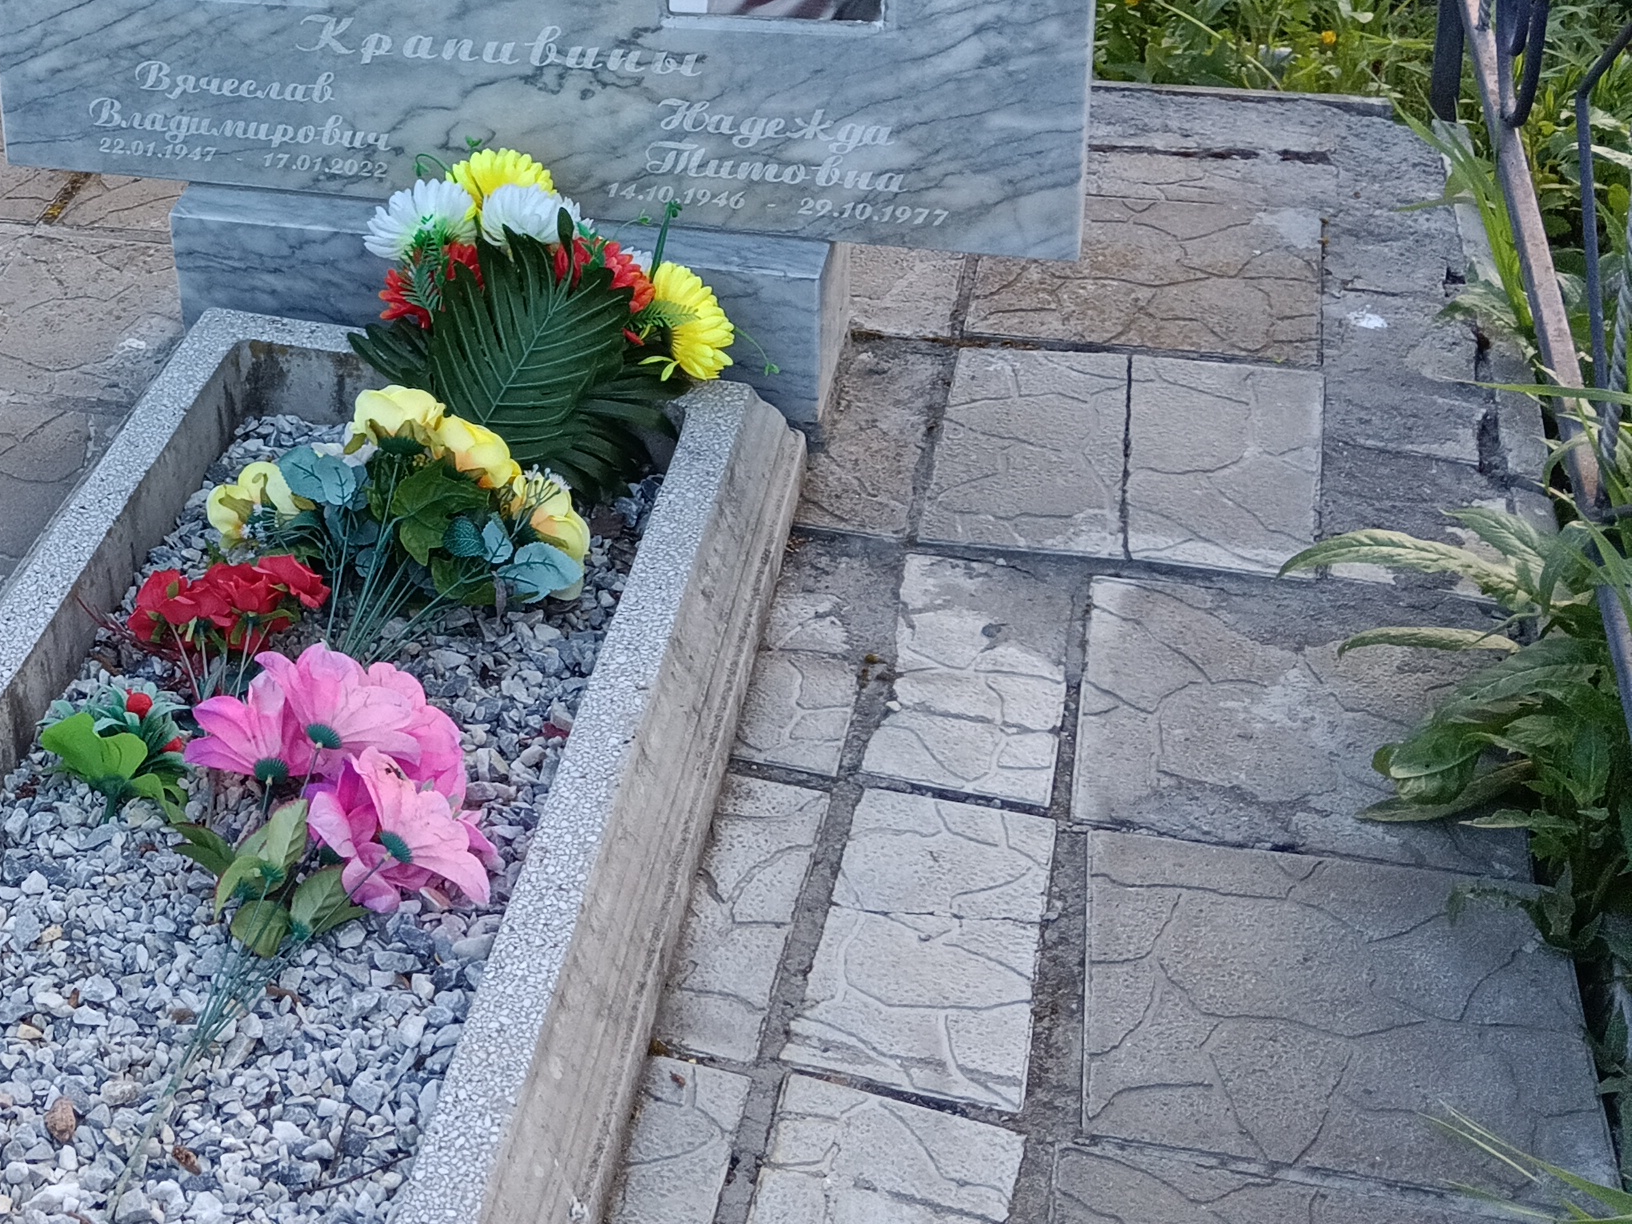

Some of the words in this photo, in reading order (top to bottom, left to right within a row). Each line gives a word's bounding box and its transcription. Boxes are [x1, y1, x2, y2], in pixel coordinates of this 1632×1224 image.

[295, 14, 707, 77] Крапивины
[134, 60, 336, 104] Вячеслав
[89, 97, 392, 152] Владимирович
[657, 98, 895, 154] Надежда
[98, 137, 218, 162] 22.01.1947
[263, 152, 389, 178] 17.01.2022
[645, 140, 908, 194] Титовна
[607, 182, 747, 210] 14.10.1946
[797, 196, 950, 227] 29.10.1977
